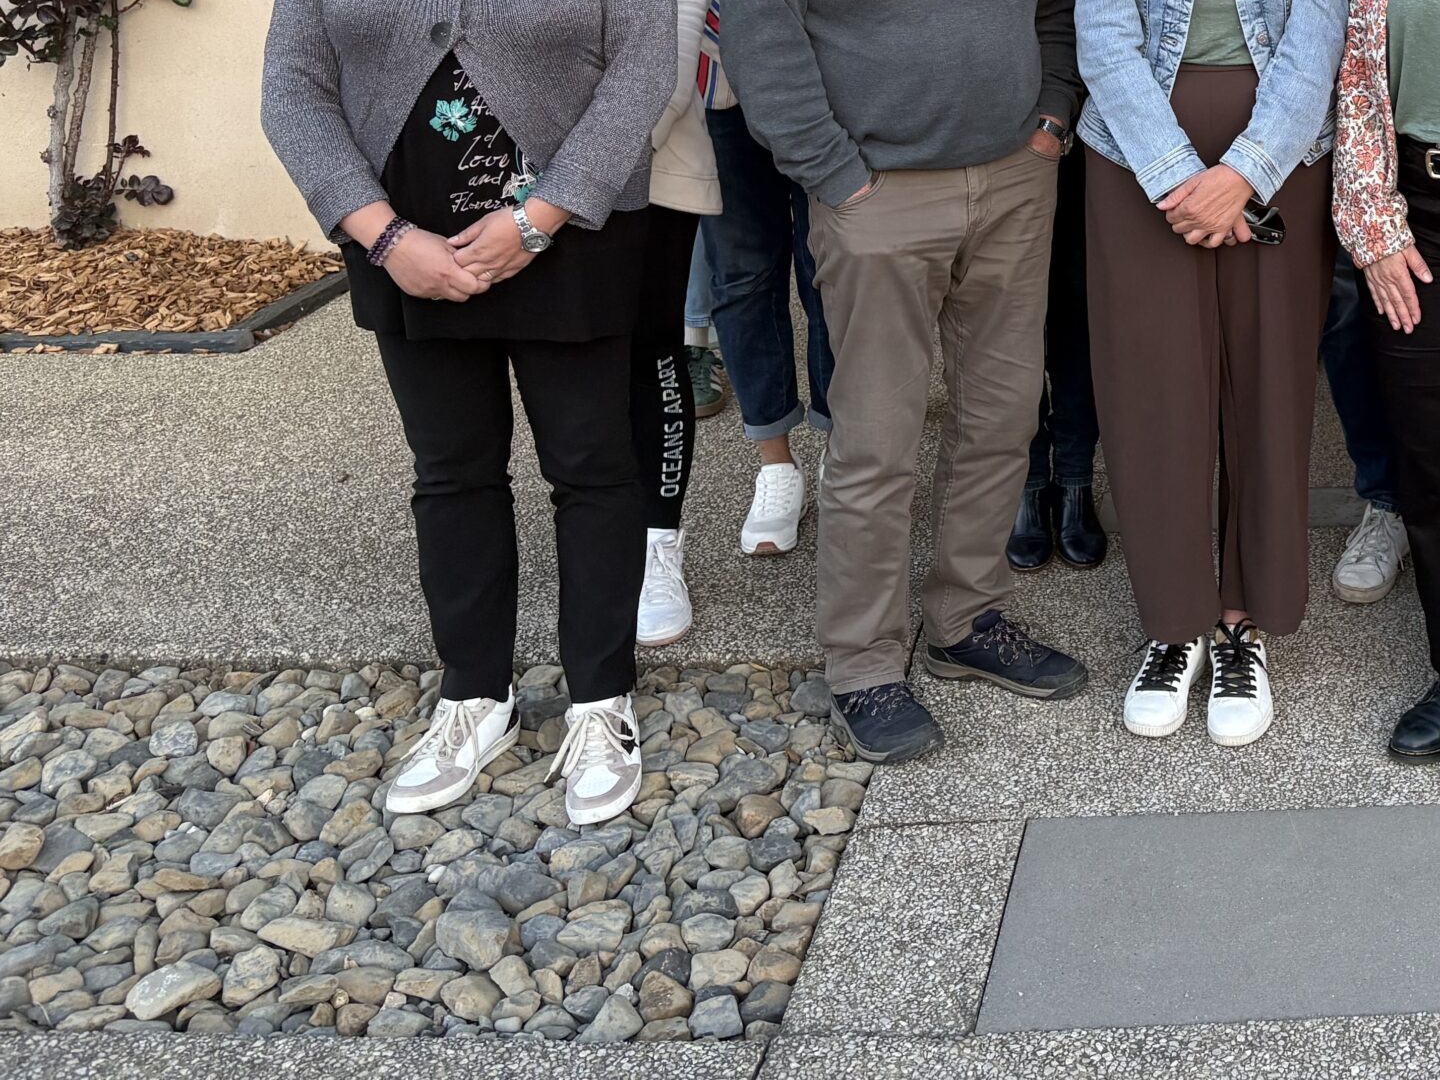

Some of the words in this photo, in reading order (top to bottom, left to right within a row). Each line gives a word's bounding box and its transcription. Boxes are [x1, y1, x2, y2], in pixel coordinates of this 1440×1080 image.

[458, 135, 510, 171] Love
[468, 171, 503, 187] and
[657, 355, 683, 414] APART
[660, 420, 684, 498] OCEANS
